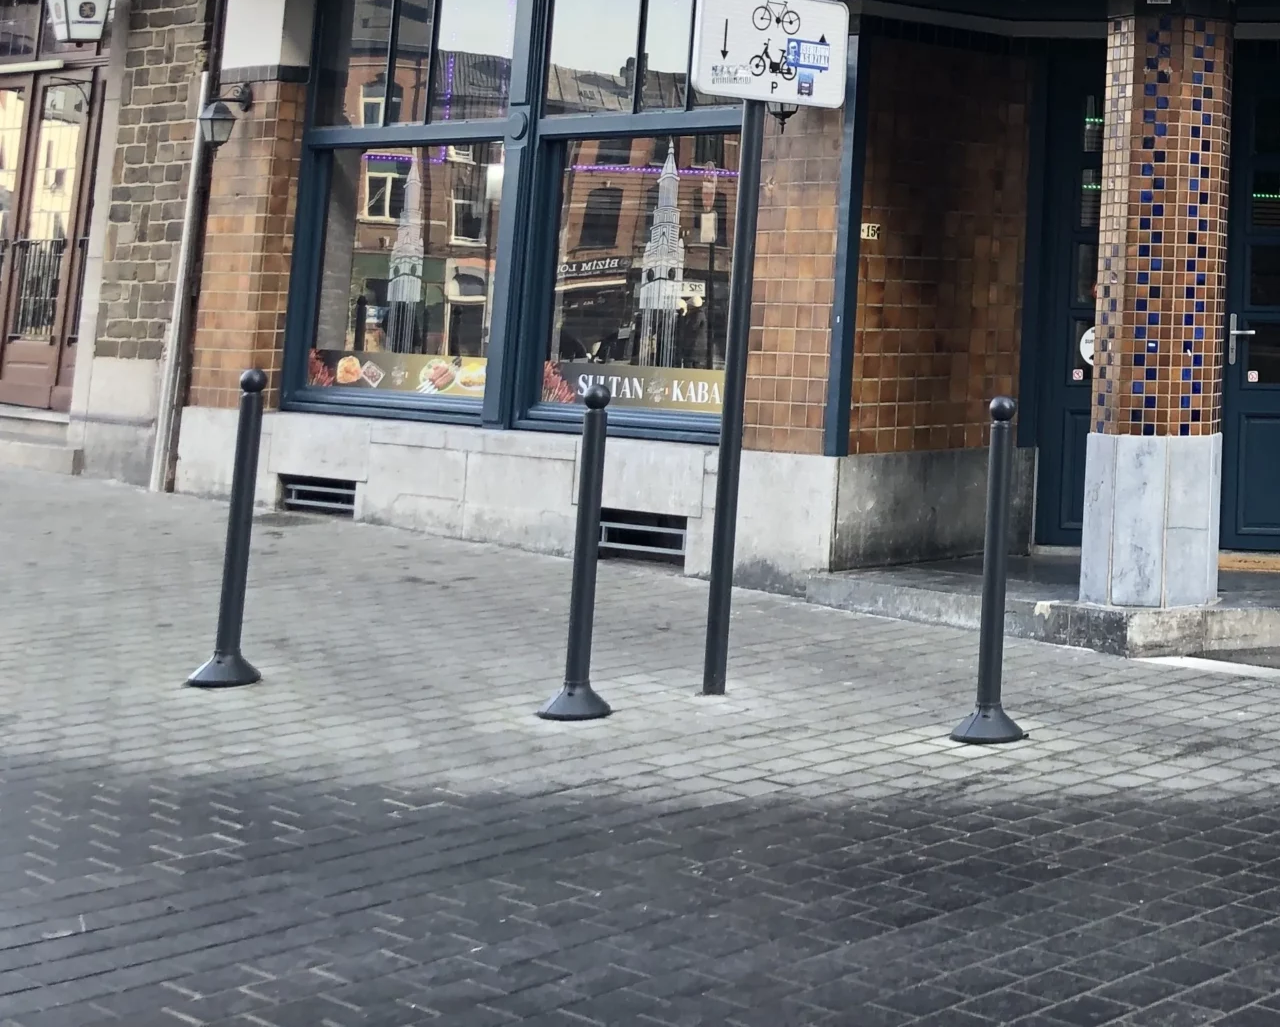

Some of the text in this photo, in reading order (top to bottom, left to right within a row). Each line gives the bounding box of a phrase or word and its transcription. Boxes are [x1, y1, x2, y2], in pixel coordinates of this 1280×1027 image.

[771, 81, 779, 94] P
[577, 373, 724, 404] SUTAN KABA
